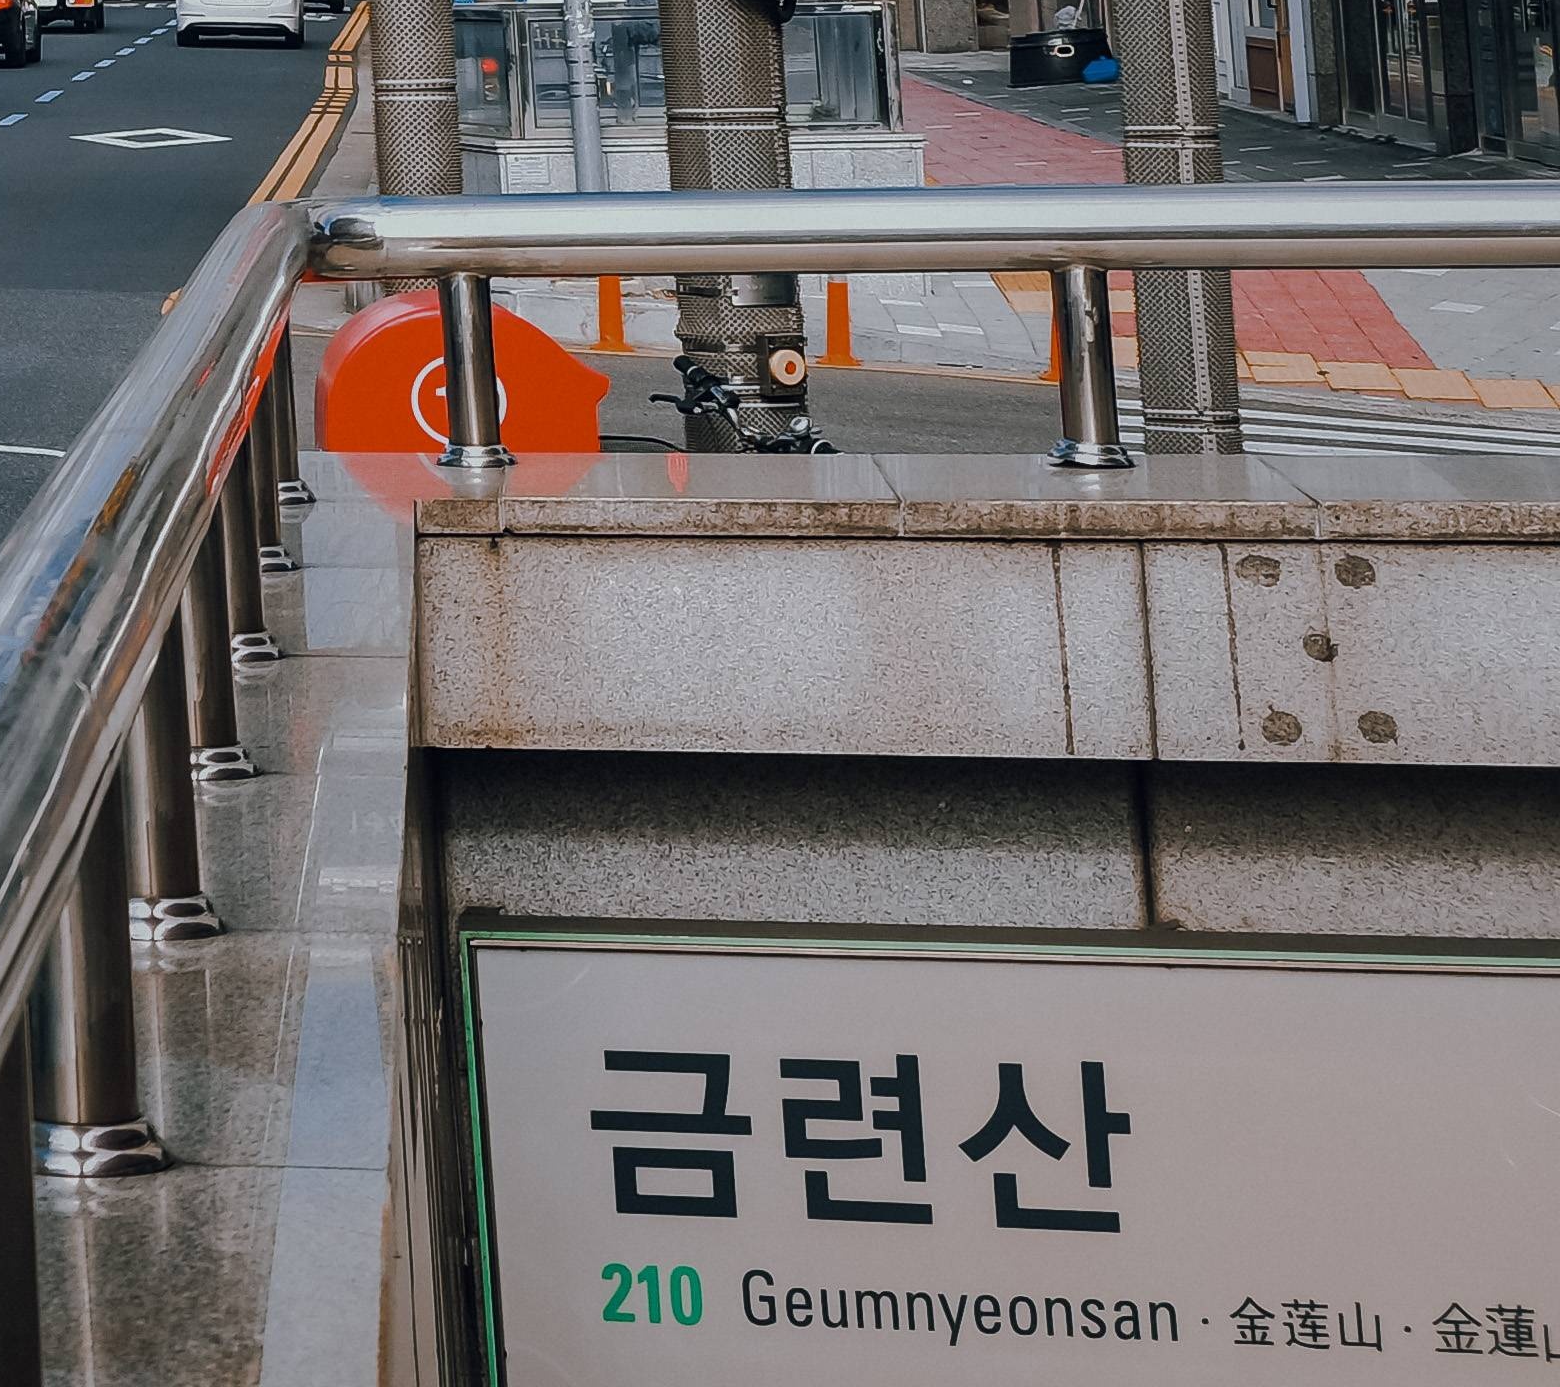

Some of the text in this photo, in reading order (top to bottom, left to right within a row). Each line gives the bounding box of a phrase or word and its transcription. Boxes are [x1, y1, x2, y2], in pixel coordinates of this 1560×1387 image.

[589, 1049, 1131, 1233] 금련산
[601, 1262, 704, 1327] 210
[741, 1268, 1180, 1346] Geumnyeonsan
[1229, 1296, 1384, 1353] 金莲山
